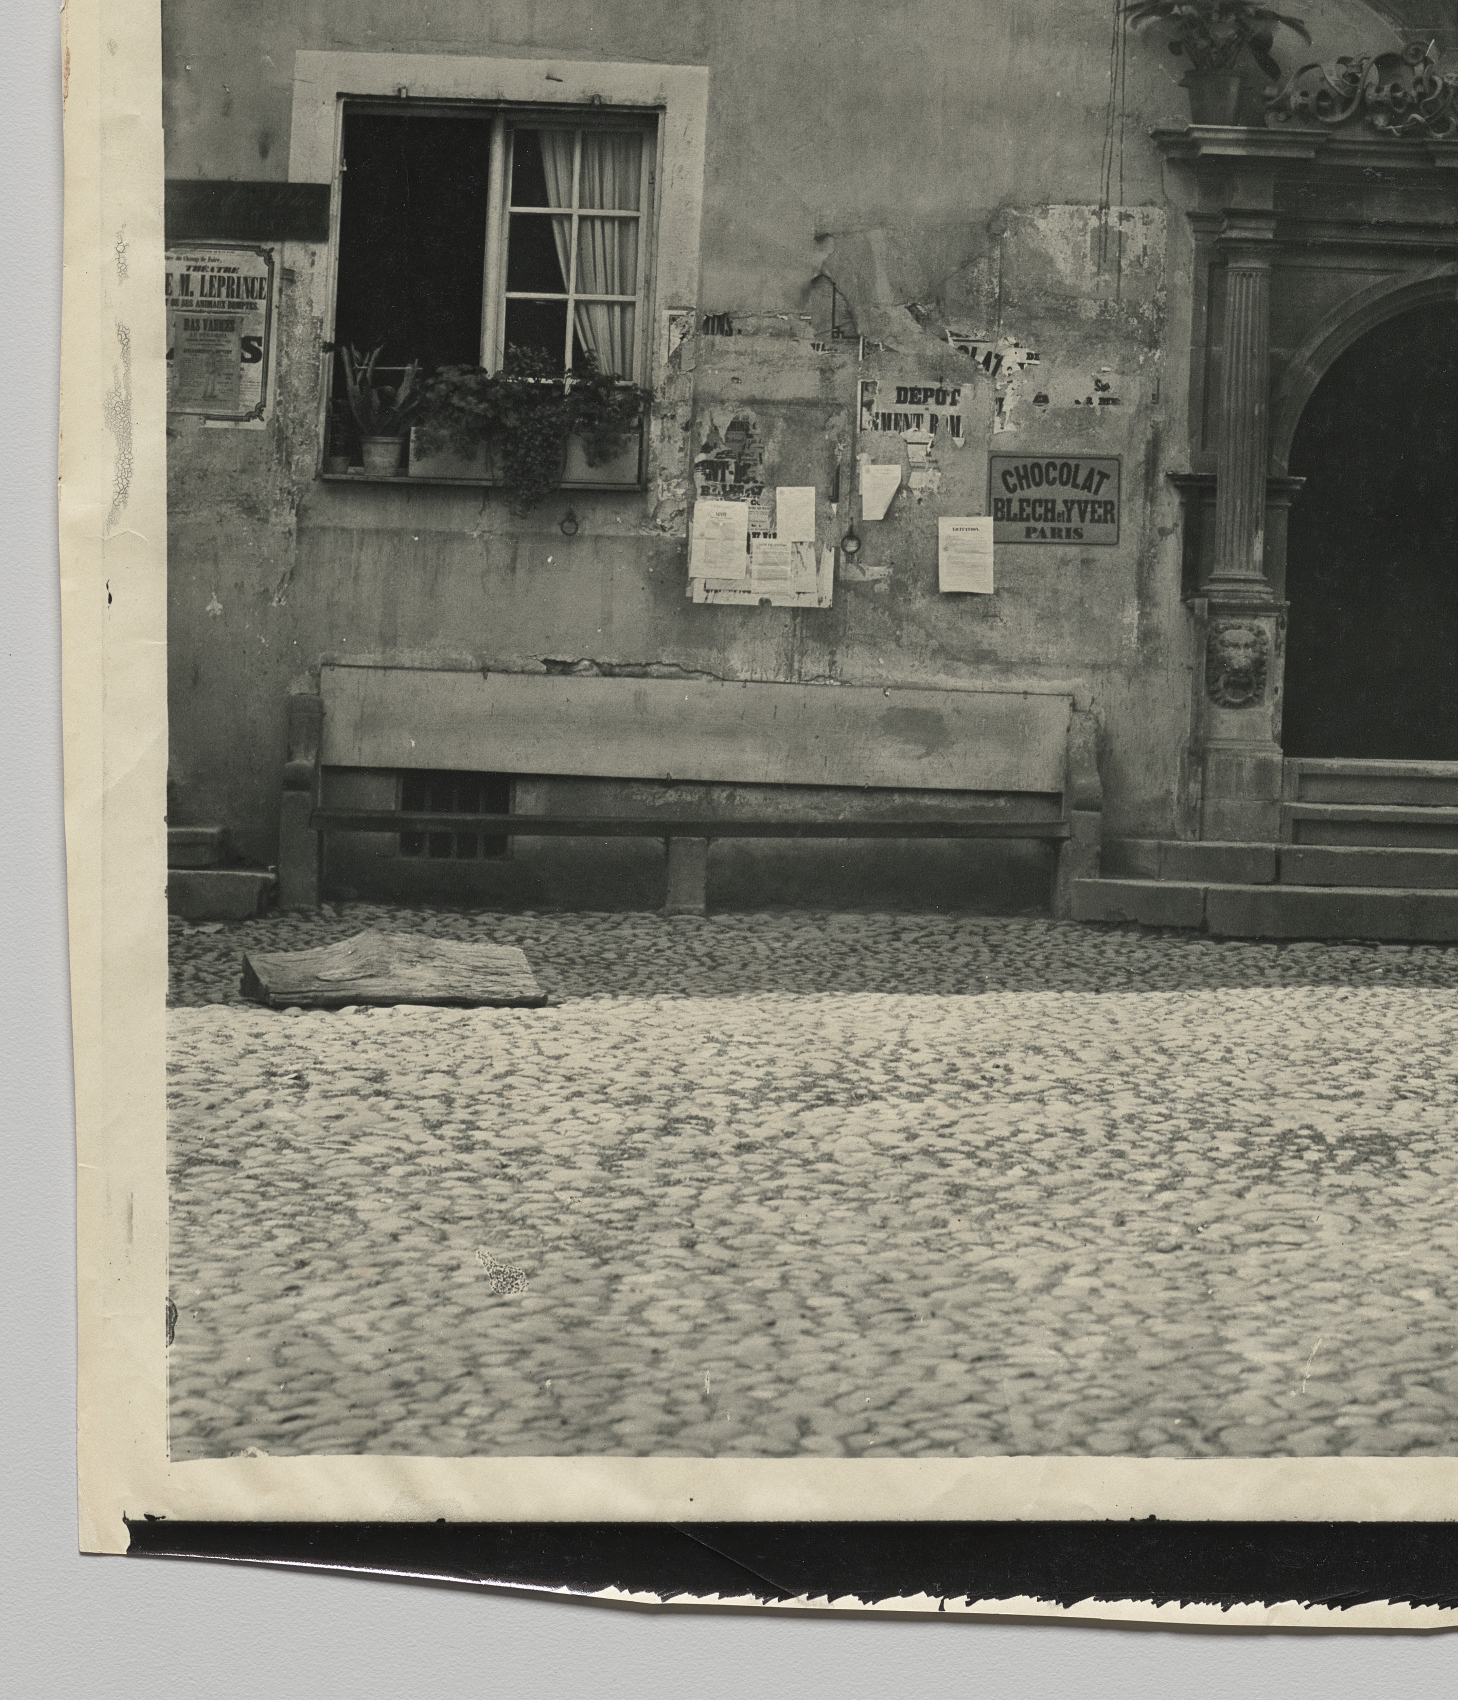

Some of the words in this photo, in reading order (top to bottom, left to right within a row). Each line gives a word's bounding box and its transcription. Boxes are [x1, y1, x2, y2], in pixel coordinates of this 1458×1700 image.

[179, 273, 195, 297] M.
[199, 274, 267, 300] LEPRINCE
[195, 299, 226, 309] ANIMAUX
[1001, 461, 1111, 496] CHOCOLAT
[993, 498, 1057, 522] BLECH
[1062, 499, 1116, 524] YVER
[1025, 526, 1084, 540] PARIS
